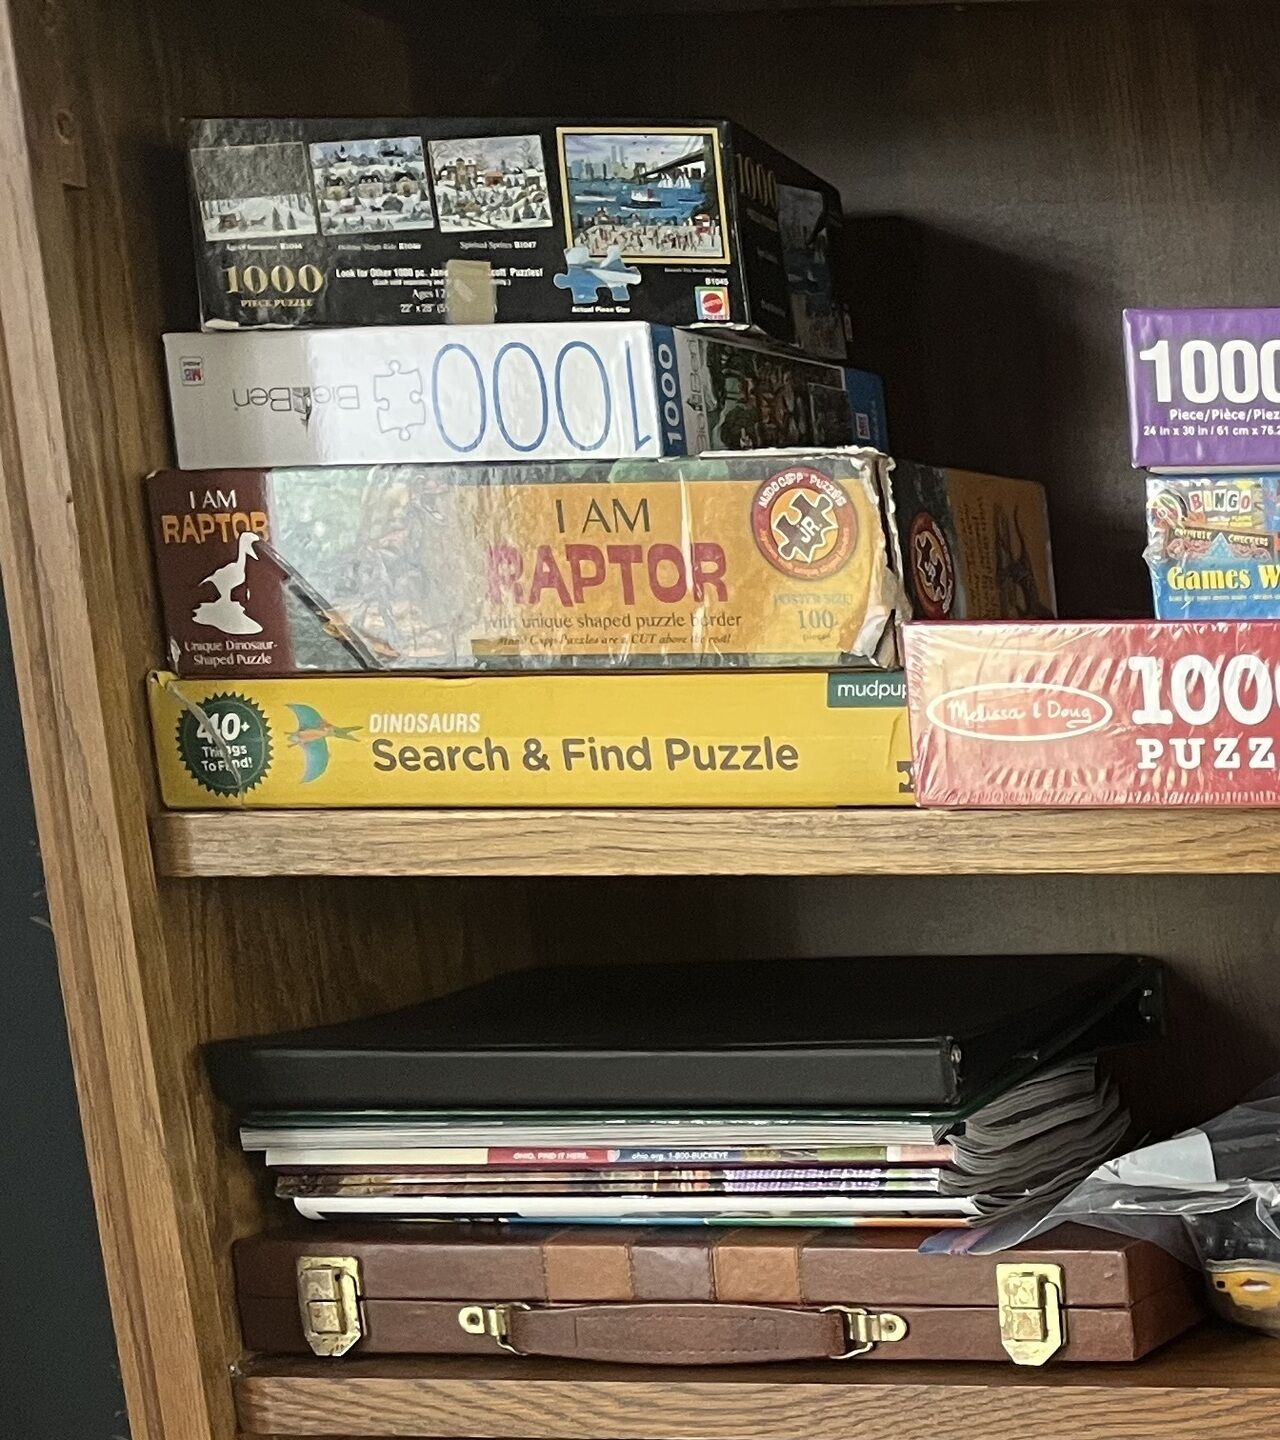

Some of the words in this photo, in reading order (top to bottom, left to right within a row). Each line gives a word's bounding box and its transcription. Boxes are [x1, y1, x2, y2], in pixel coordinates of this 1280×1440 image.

[225, 264, 324, 295] 1000
[431, 341, 652, 453] 1000
[658, 343, 684, 446] 1000
[556, 500, 565, 532] I
[583, 498, 651, 533] AM
[486, 542, 730, 607] RAPTOR
[1168, 566, 1251, 591] Games
[369, 713, 480, 733] DINOSAURS
[947, 699, 1021, 724] Melissa
[1046, 697, 1093, 726] Doug
[373, 738, 512, 773] Search
[523, 739, 547, 771] &
[564, 736, 654, 771] Find
[667, 736, 799, 771] Puzzle
